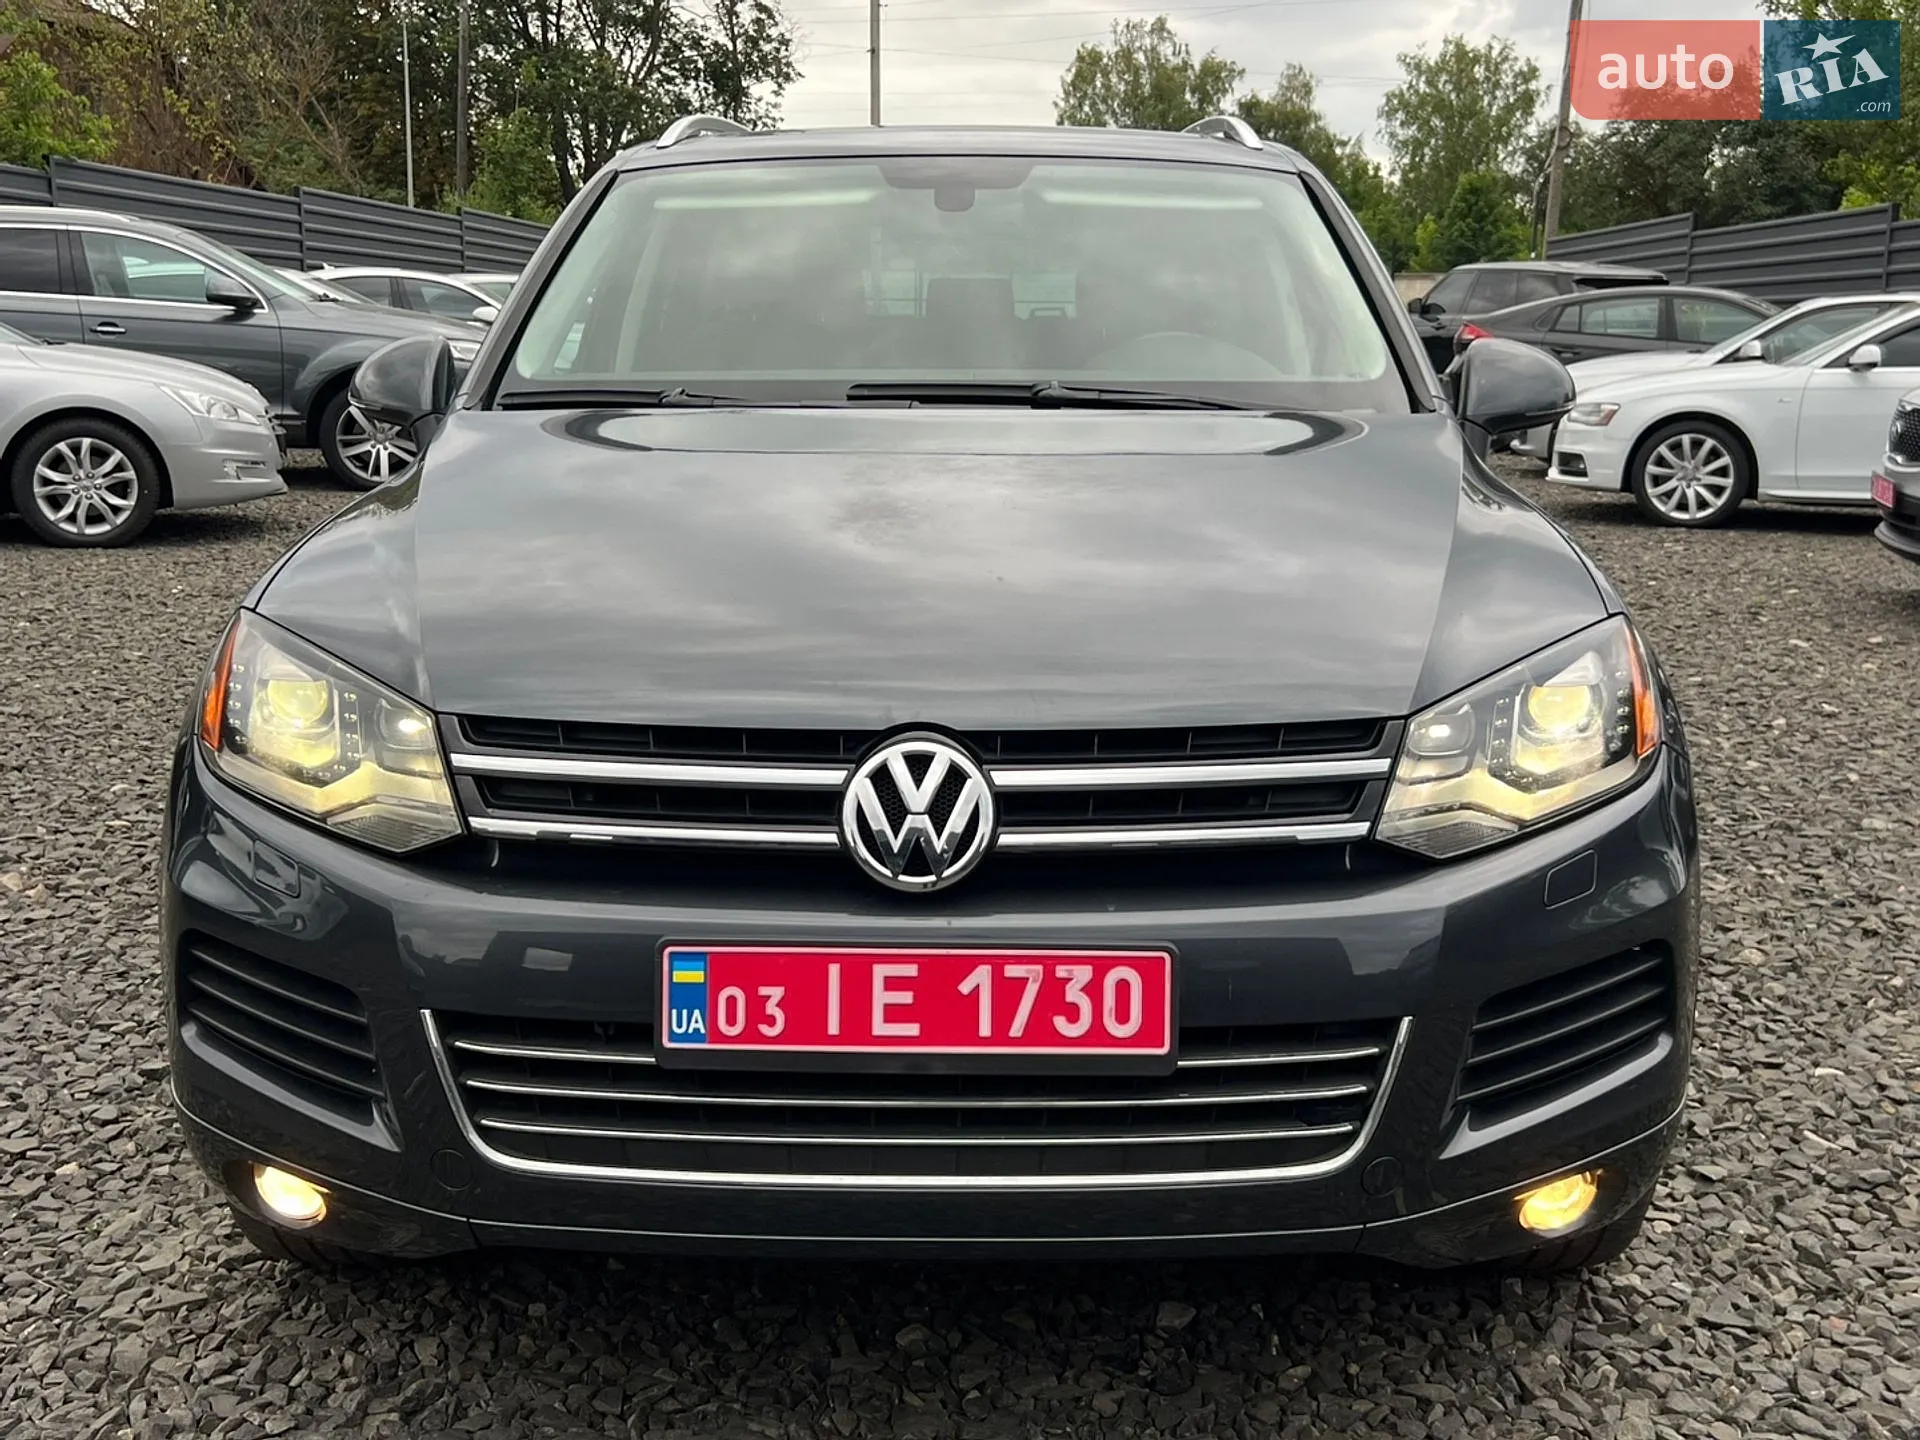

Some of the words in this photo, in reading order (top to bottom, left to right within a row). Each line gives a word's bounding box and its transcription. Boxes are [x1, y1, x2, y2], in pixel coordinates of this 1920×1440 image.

[848, 746, 988, 887] VW
[671, 1008, 706, 1035] UA
[717, 986, 785, 1037] 03
[827, 962, 920, 1037] IE
[957, 963, 1143, 1039] 1730
